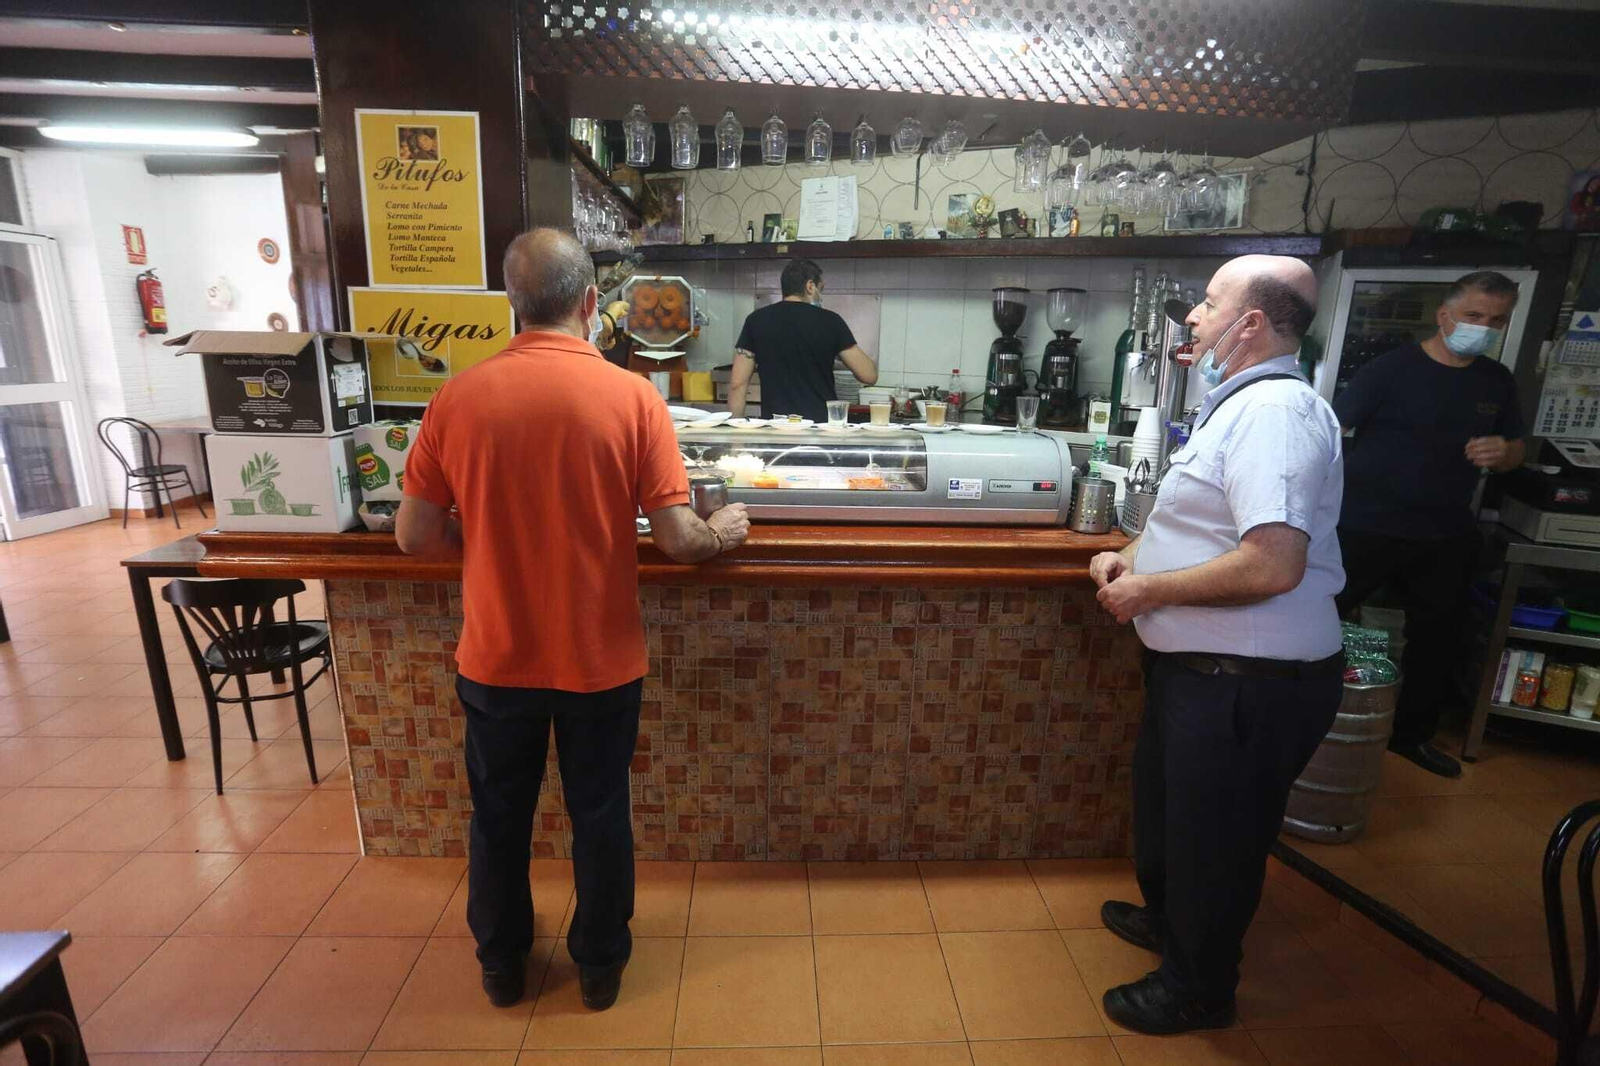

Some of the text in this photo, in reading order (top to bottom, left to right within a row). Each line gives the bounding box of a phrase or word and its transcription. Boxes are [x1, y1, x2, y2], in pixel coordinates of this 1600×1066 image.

[373, 157, 469, 191] Pitufos
[385, 201, 448, 210] Carne Mechada
[386, 212, 423, 220] Serranito
[387, 222, 410, 231] Lomo
[428, 223, 463, 232] Pimiento
[388, 233, 446, 242] Lomo Manteca
[389, 243, 454, 254] Tortilla Campera
[390, 254, 456, 264] Tortilla Española
[367, 308, 506, 351] Migas
[389, 440, 402, 450] SAL
[366, 473, 387, 488] SAL
